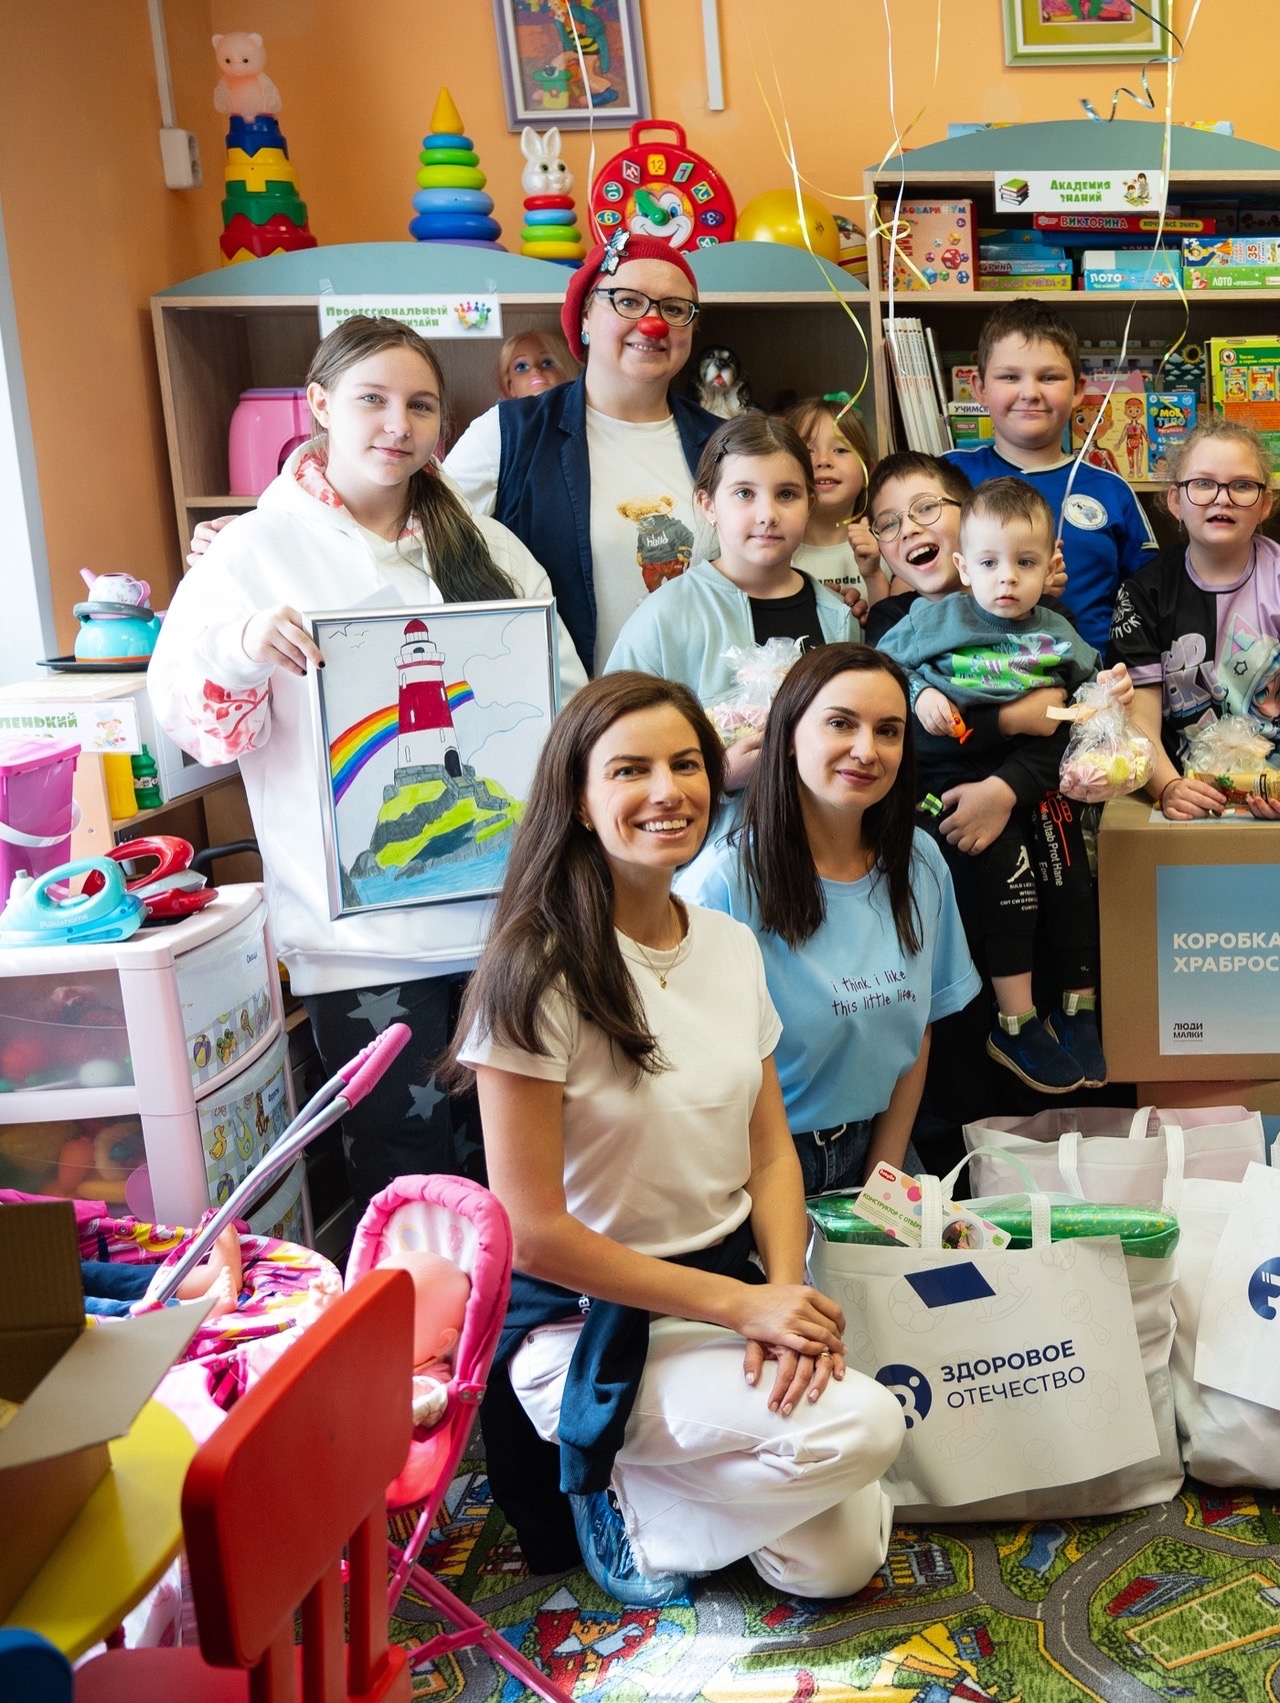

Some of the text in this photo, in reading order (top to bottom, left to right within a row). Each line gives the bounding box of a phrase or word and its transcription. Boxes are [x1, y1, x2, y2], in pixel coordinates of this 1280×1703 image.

[650, 159, 664, 171] 12
[1060, 215, 1129, 229] ВИКТОРИНА
[1247, 244, 1258, 259] 35
[1090, 273, 1122, 283] ЛОТО
[1212, 276, 1233, 287] ЛОТО
[954, 405, 988, 413] УЧИМСЯ
[1049, 841, 1061, 863] Prot
[830, 969, 907, 994] i think i like
[831, 999, 858, 1017] this
[862, 992, 892, 1011] little
[1172, 1021, 1204, 1031] ЛЮДИ
[1172, 1031, 1204, 1040] МАЯКИ
[862, 1192, 899, 1217] КОНСТРУКТОР
[940, 1339, 1076, 1383] ЗДОРОВОЕ
[946, 1365, 1086, 1409] ОТЕЧЕСТВО
